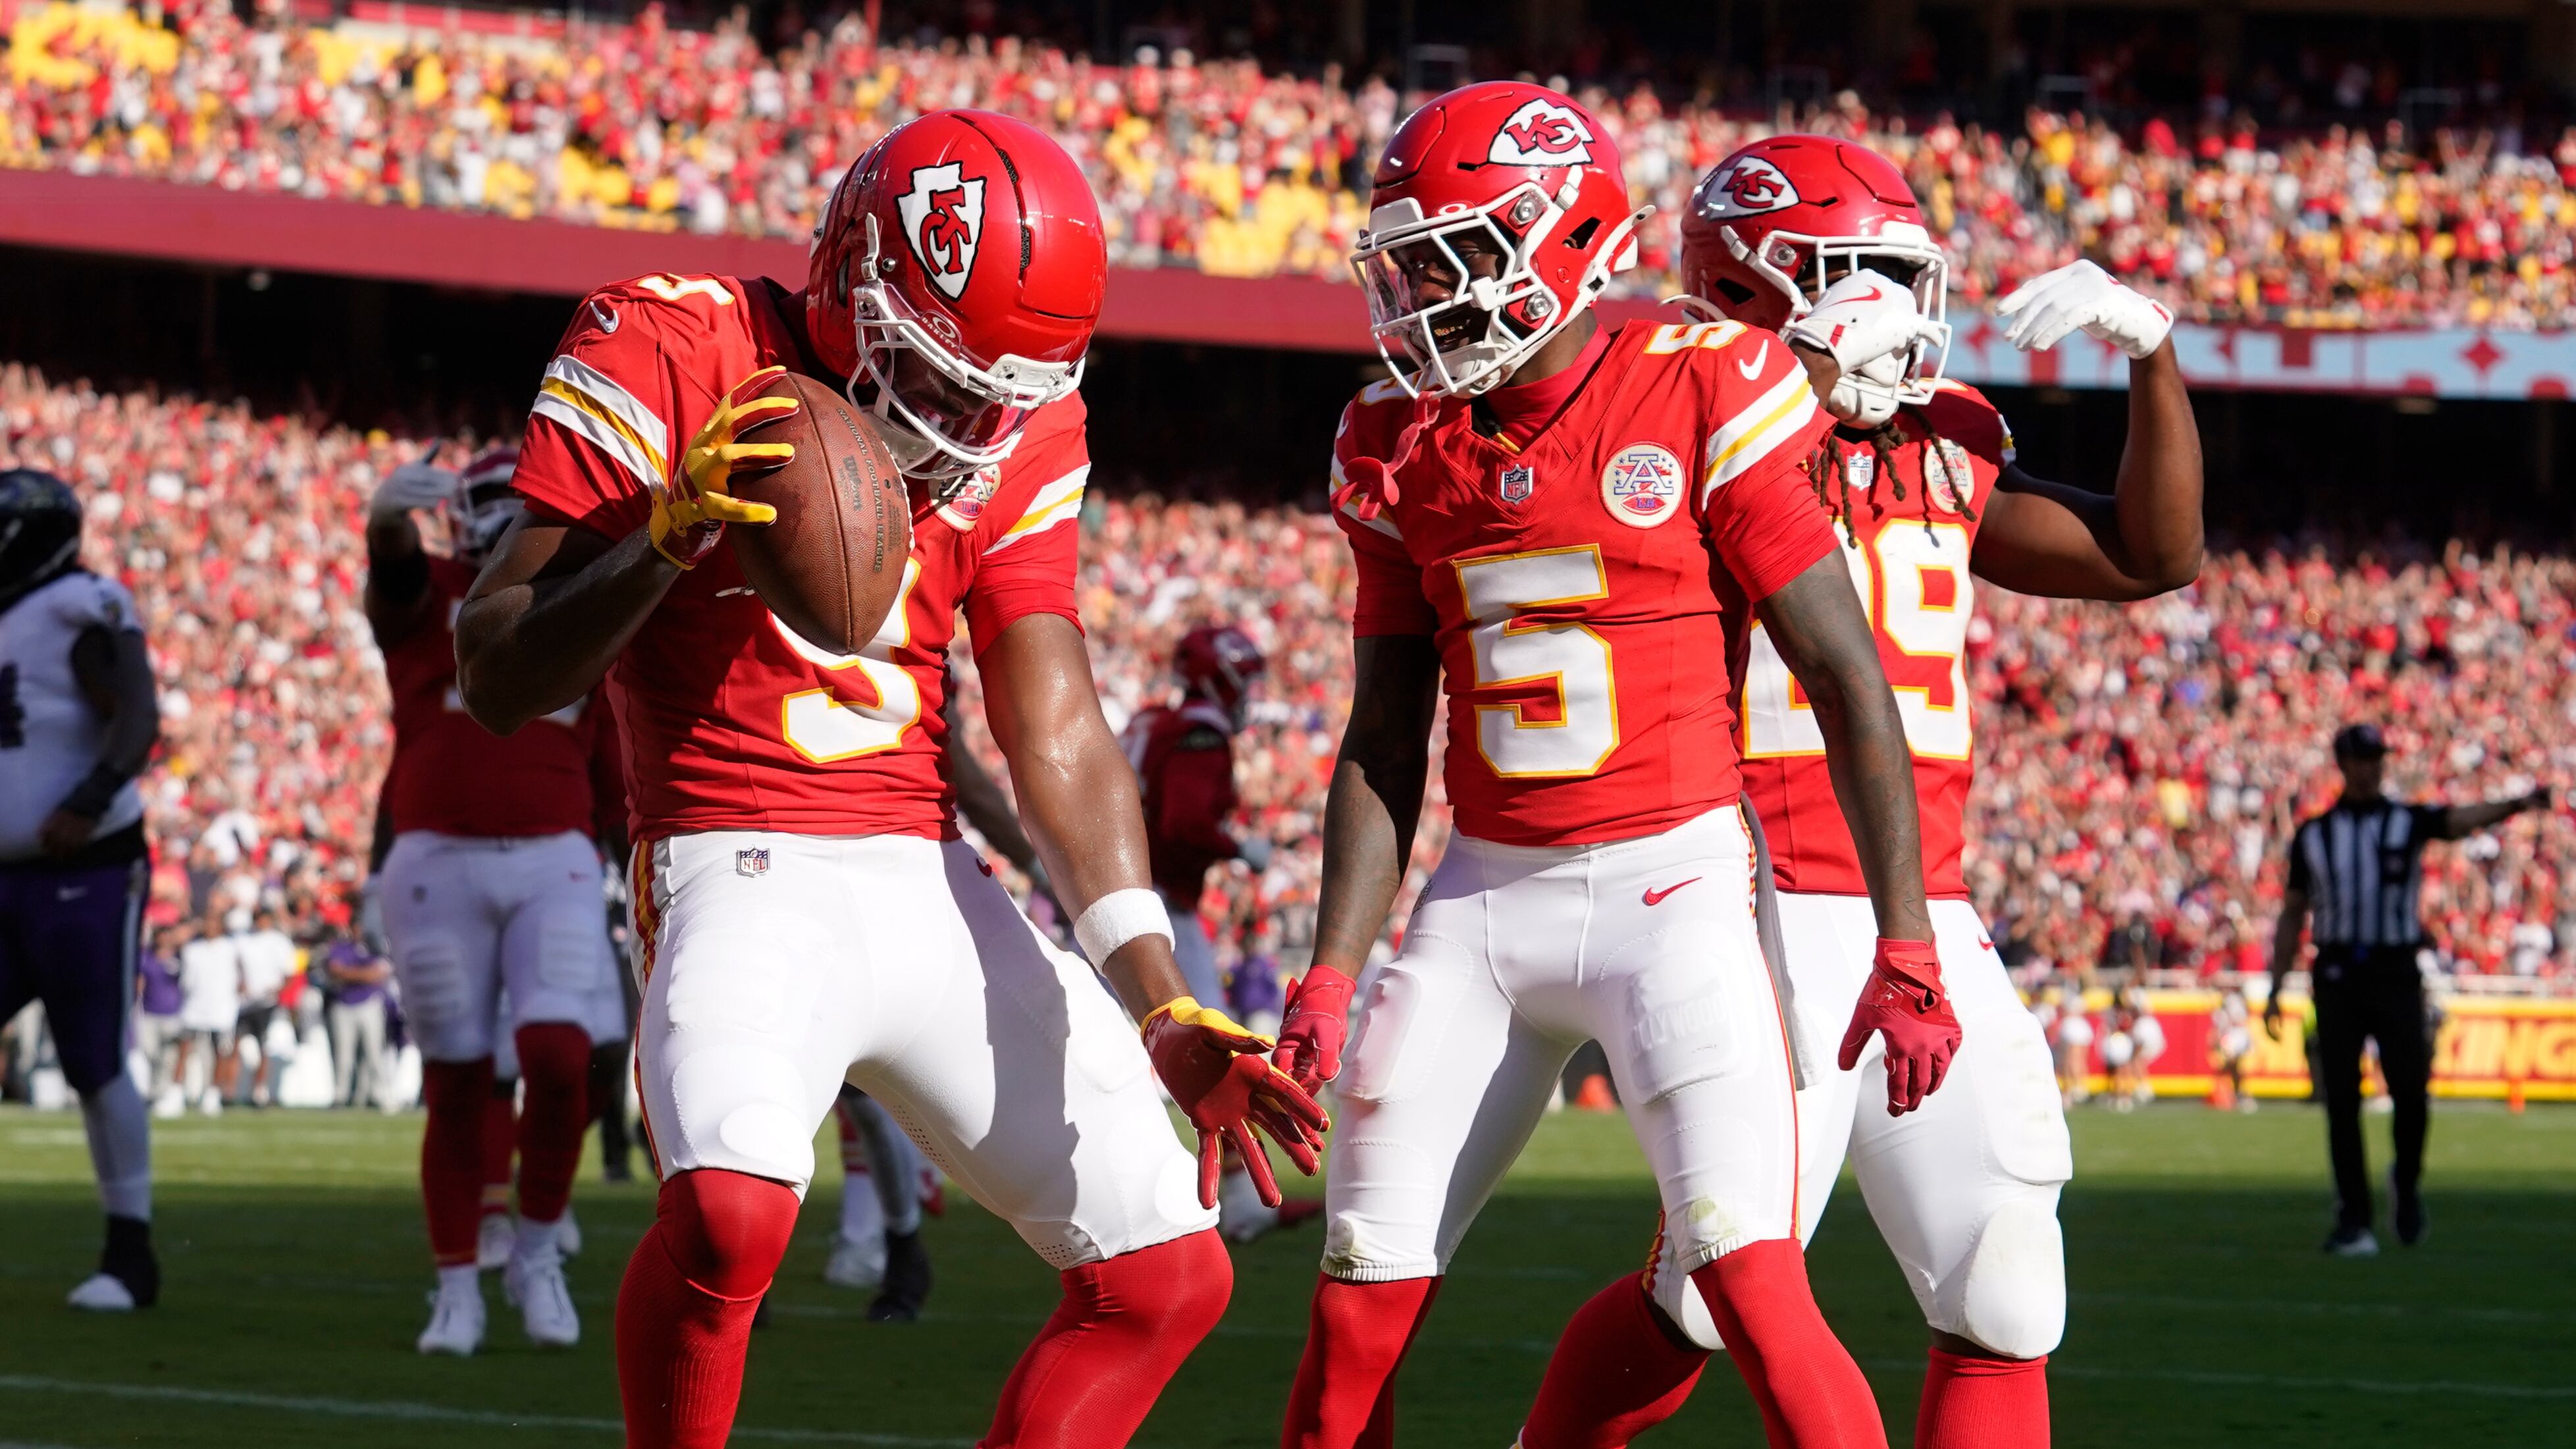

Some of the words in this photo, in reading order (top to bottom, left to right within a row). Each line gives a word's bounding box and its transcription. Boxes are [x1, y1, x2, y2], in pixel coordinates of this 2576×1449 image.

[1506, 111, 1581, 155] KC
[1723, 167, 1784, 208] KC
[920, 185, 972, 278] KC
[921, 317, 958, 349] OAKLEY
[1643, 321, 1747, 356] 5
[836, 408, 869, 456] NATIONAL
[865, 458, 884, 520] FOOTBALL
[1506, 481, 1527, 497] NFL
[874, 523, 885, 573] LEAGUE
[1451, 543, 1620, 777] 5
[743, 858, 766, 872] NFL
